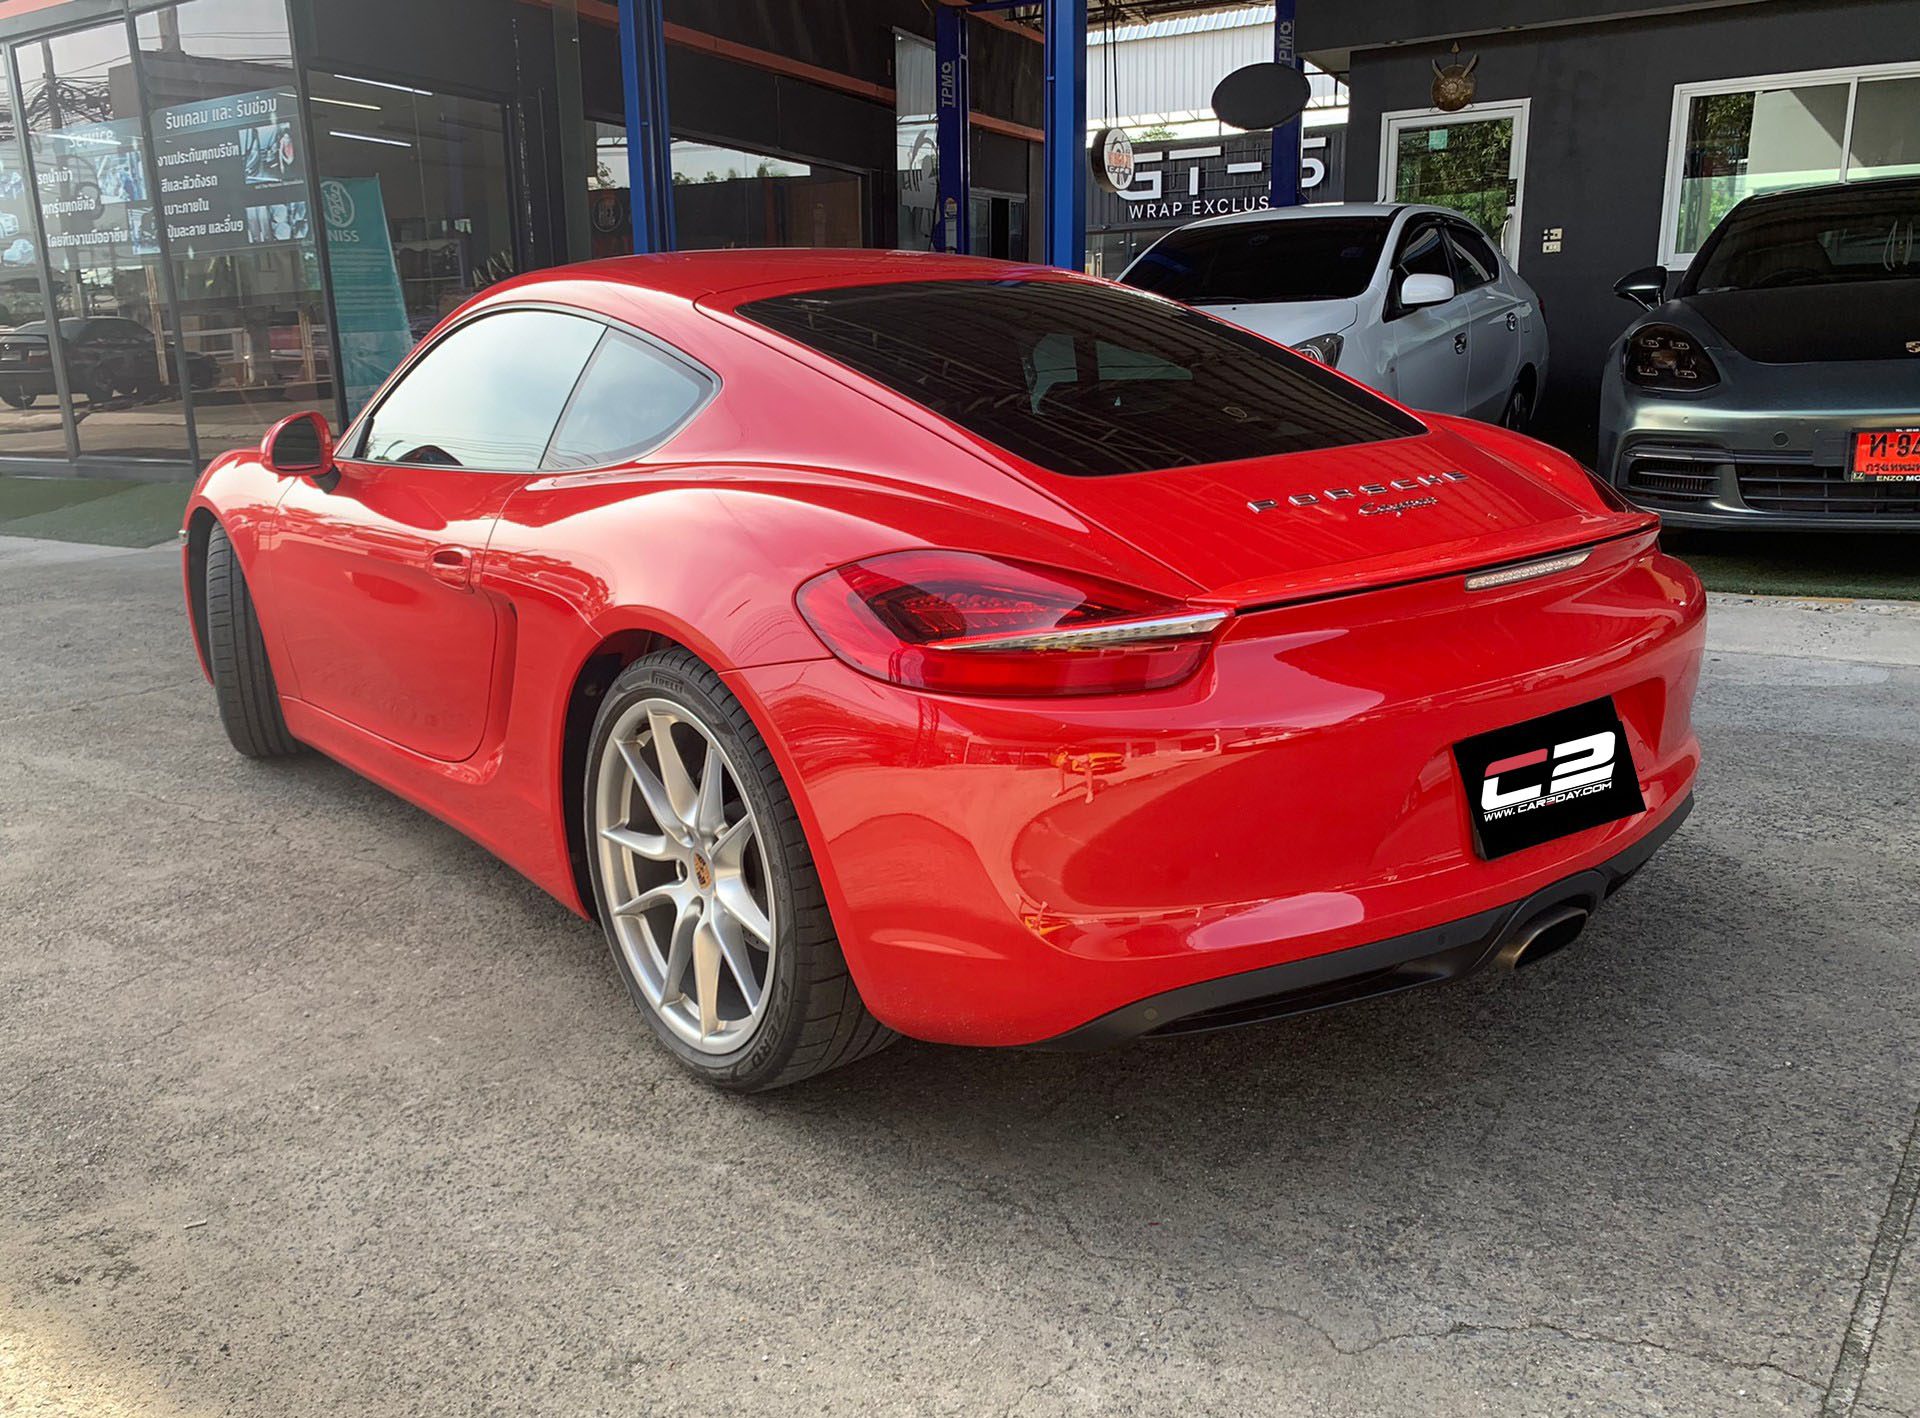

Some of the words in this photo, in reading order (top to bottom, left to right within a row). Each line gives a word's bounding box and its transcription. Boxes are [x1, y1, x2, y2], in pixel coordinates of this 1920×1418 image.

[165, 108, 208, 129] รับเคลม
[212, 107, 232, 121] และ
[236, 96, 277, 117] รับซ่อม
[69, 129, 114, 148] Service
[157, 142, 240, 167] งานประกันทุกบริษัท
[161, 174, 218, 193] สีและตัวถังรถ
[164, 197, 210, 216] เบาะภายใน
[1129, 202, 1182, 219] WRAP
[47, 227, 128, 248] โดยทีมงานมืออาชีพ
[1247, 471, 1469, 513] PORSCHE
